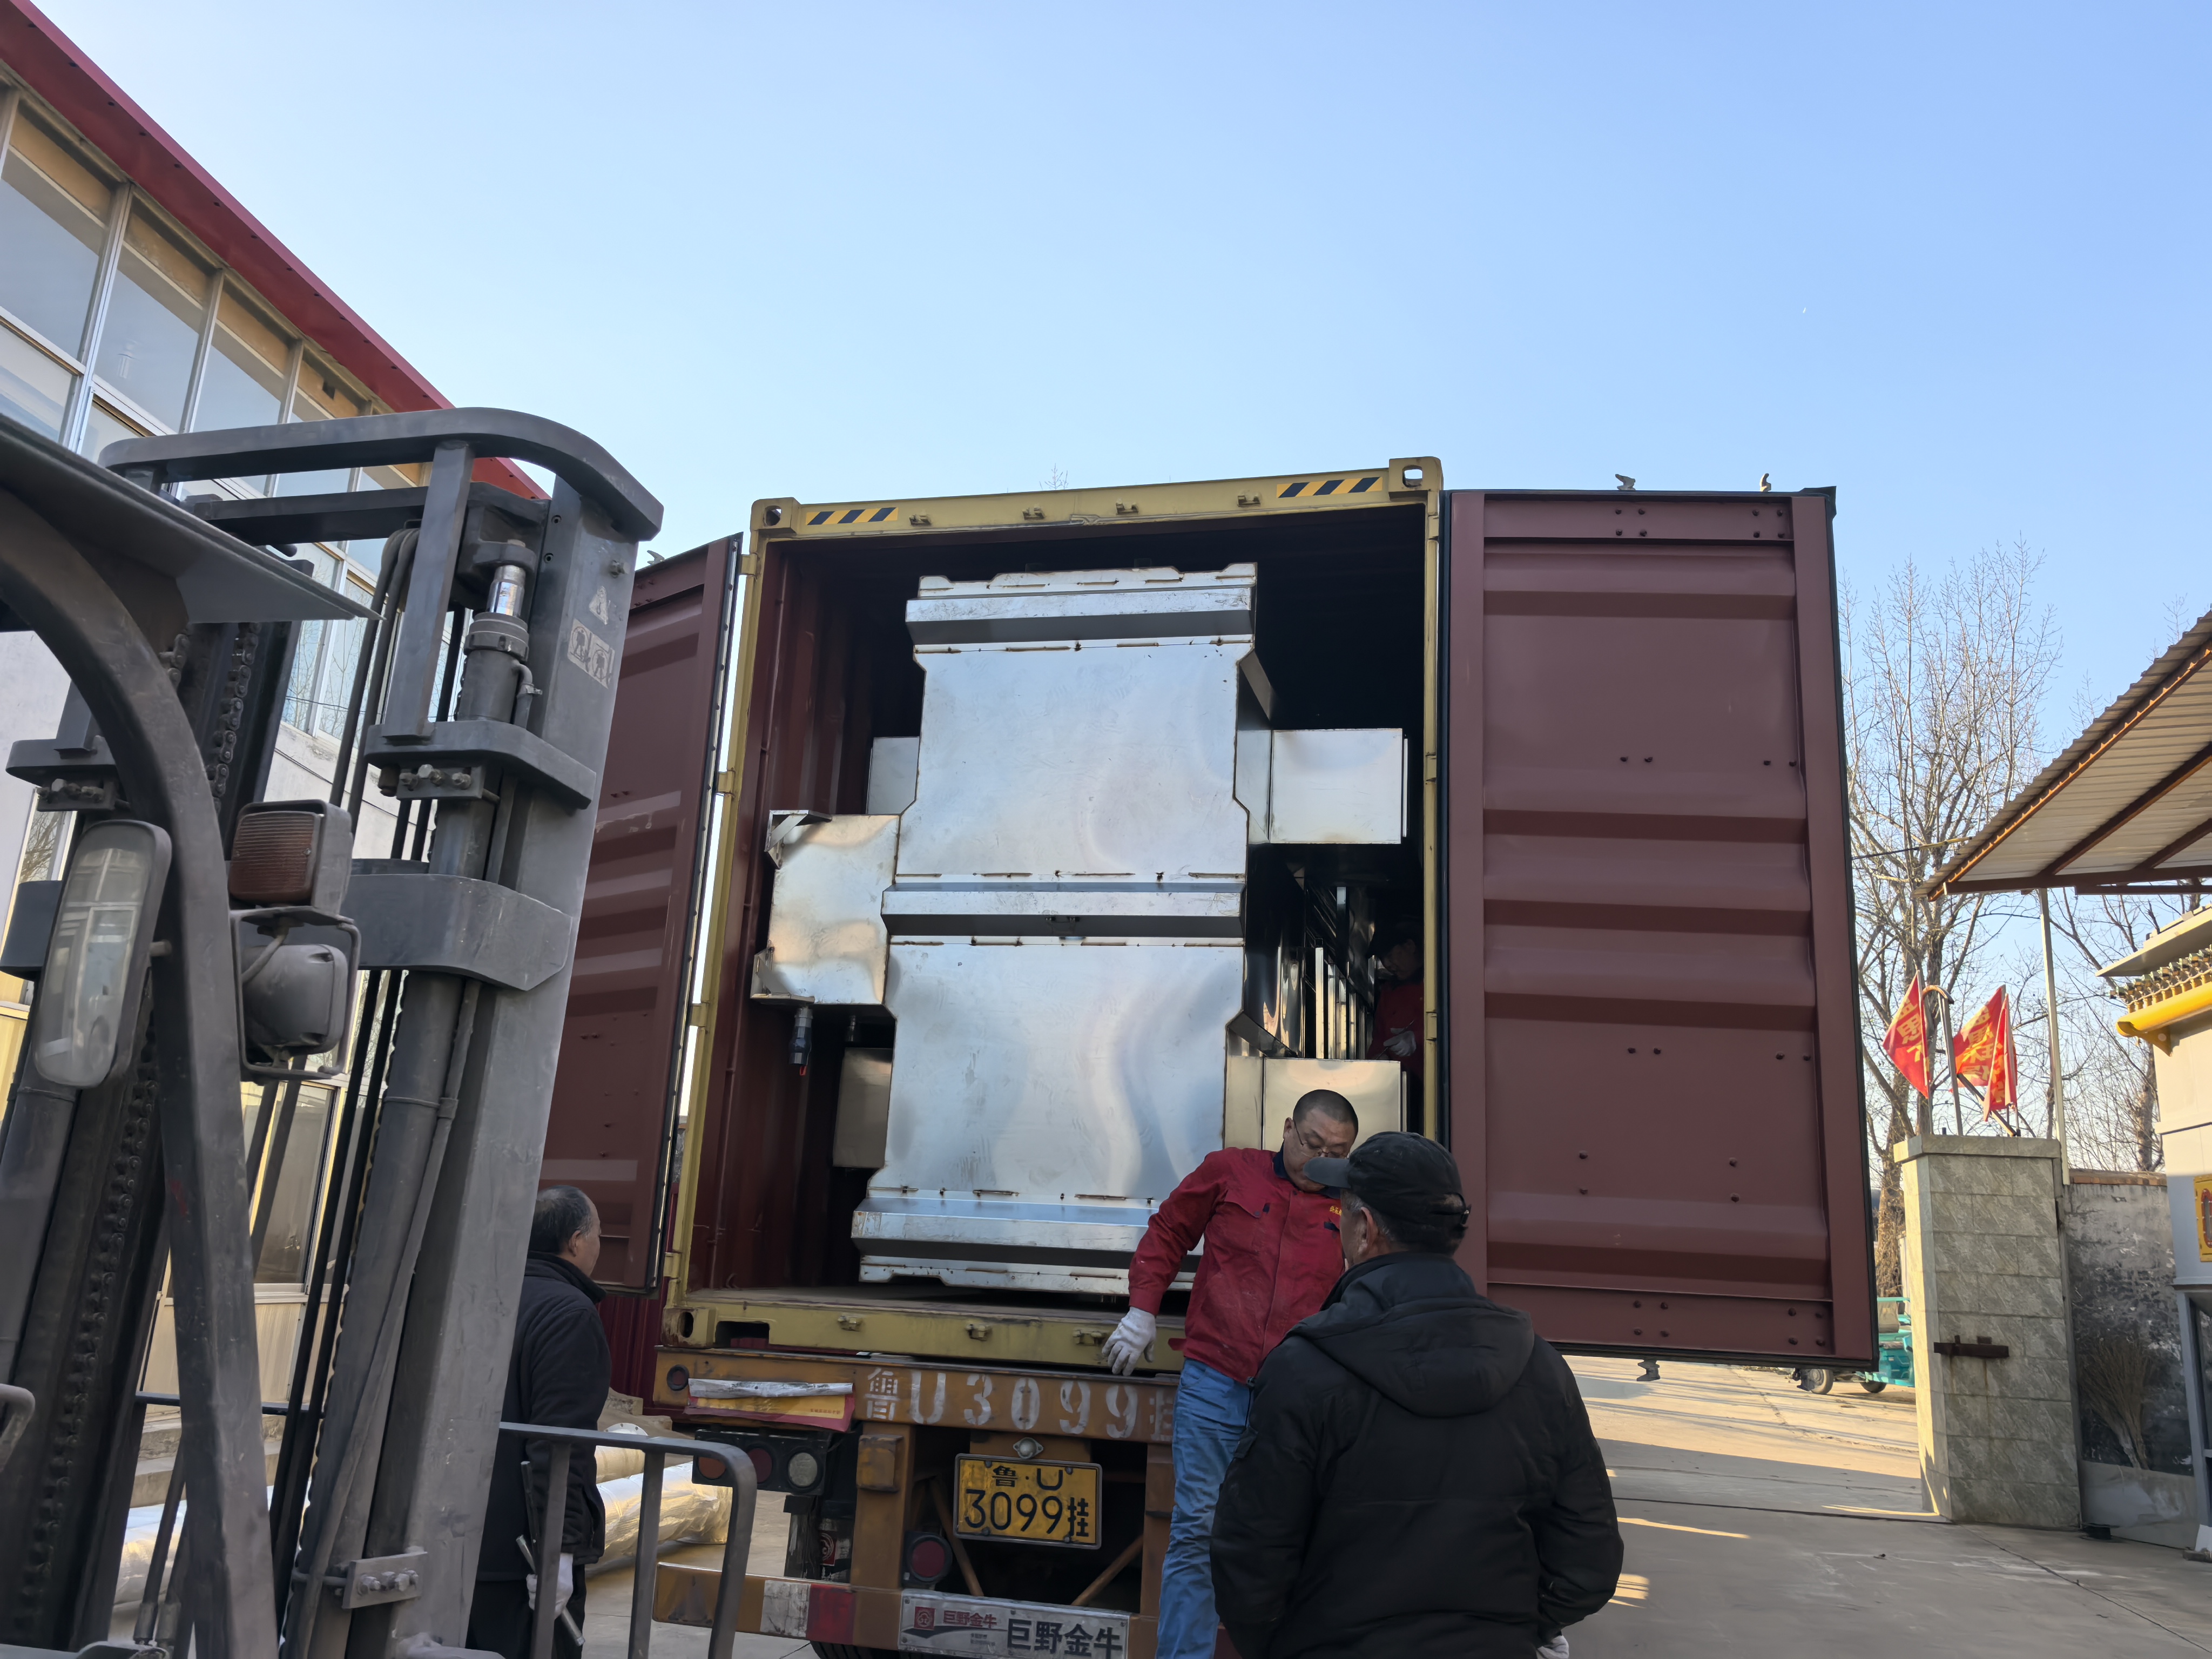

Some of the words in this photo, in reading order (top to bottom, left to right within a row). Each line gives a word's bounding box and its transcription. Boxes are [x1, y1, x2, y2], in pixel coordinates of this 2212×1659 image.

[965, 1489, 1089, 1537] 3099挂
[943, 1610, 997, 1629] 巨野金牛
[1008, 1618, 1123, 1659] 巨野金牛
